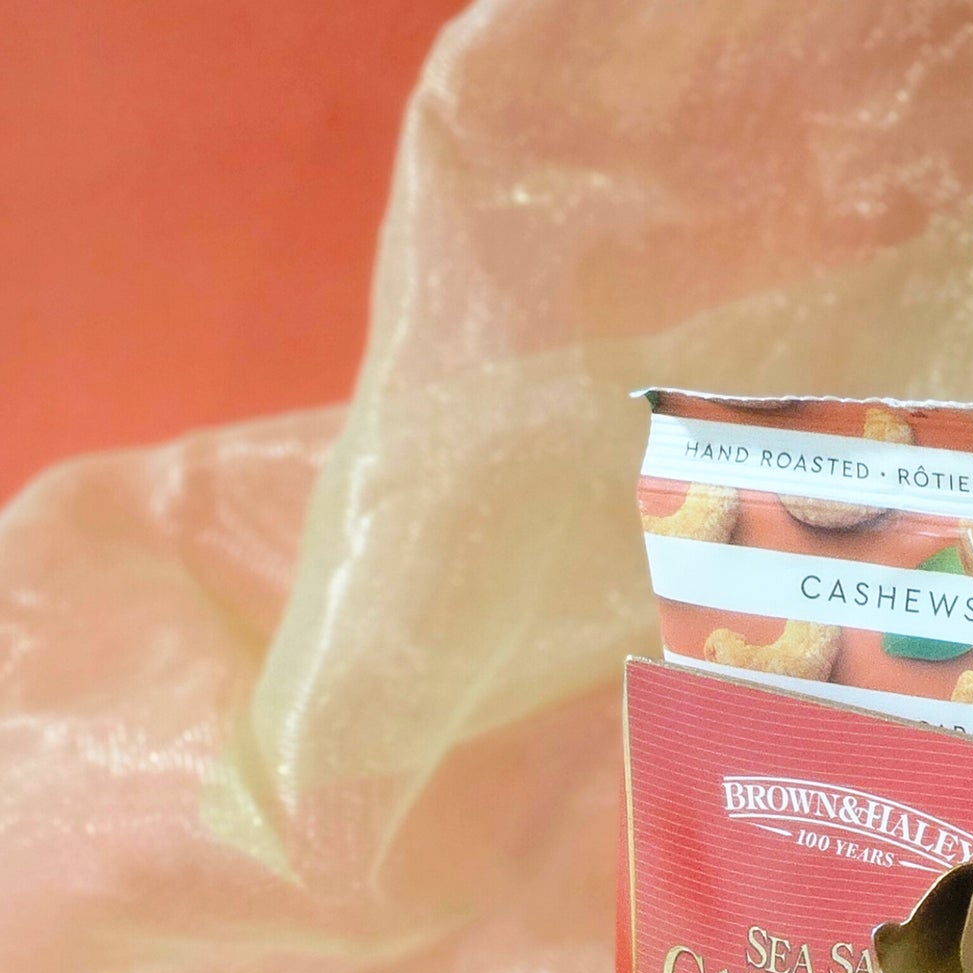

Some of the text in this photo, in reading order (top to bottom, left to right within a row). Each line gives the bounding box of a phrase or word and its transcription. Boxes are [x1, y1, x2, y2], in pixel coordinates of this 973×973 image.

[684, 441, 749, 464] HAND
[760, 449, 869, 479] ROASTED
[796, 829, 894, 868] 100 YEARS
